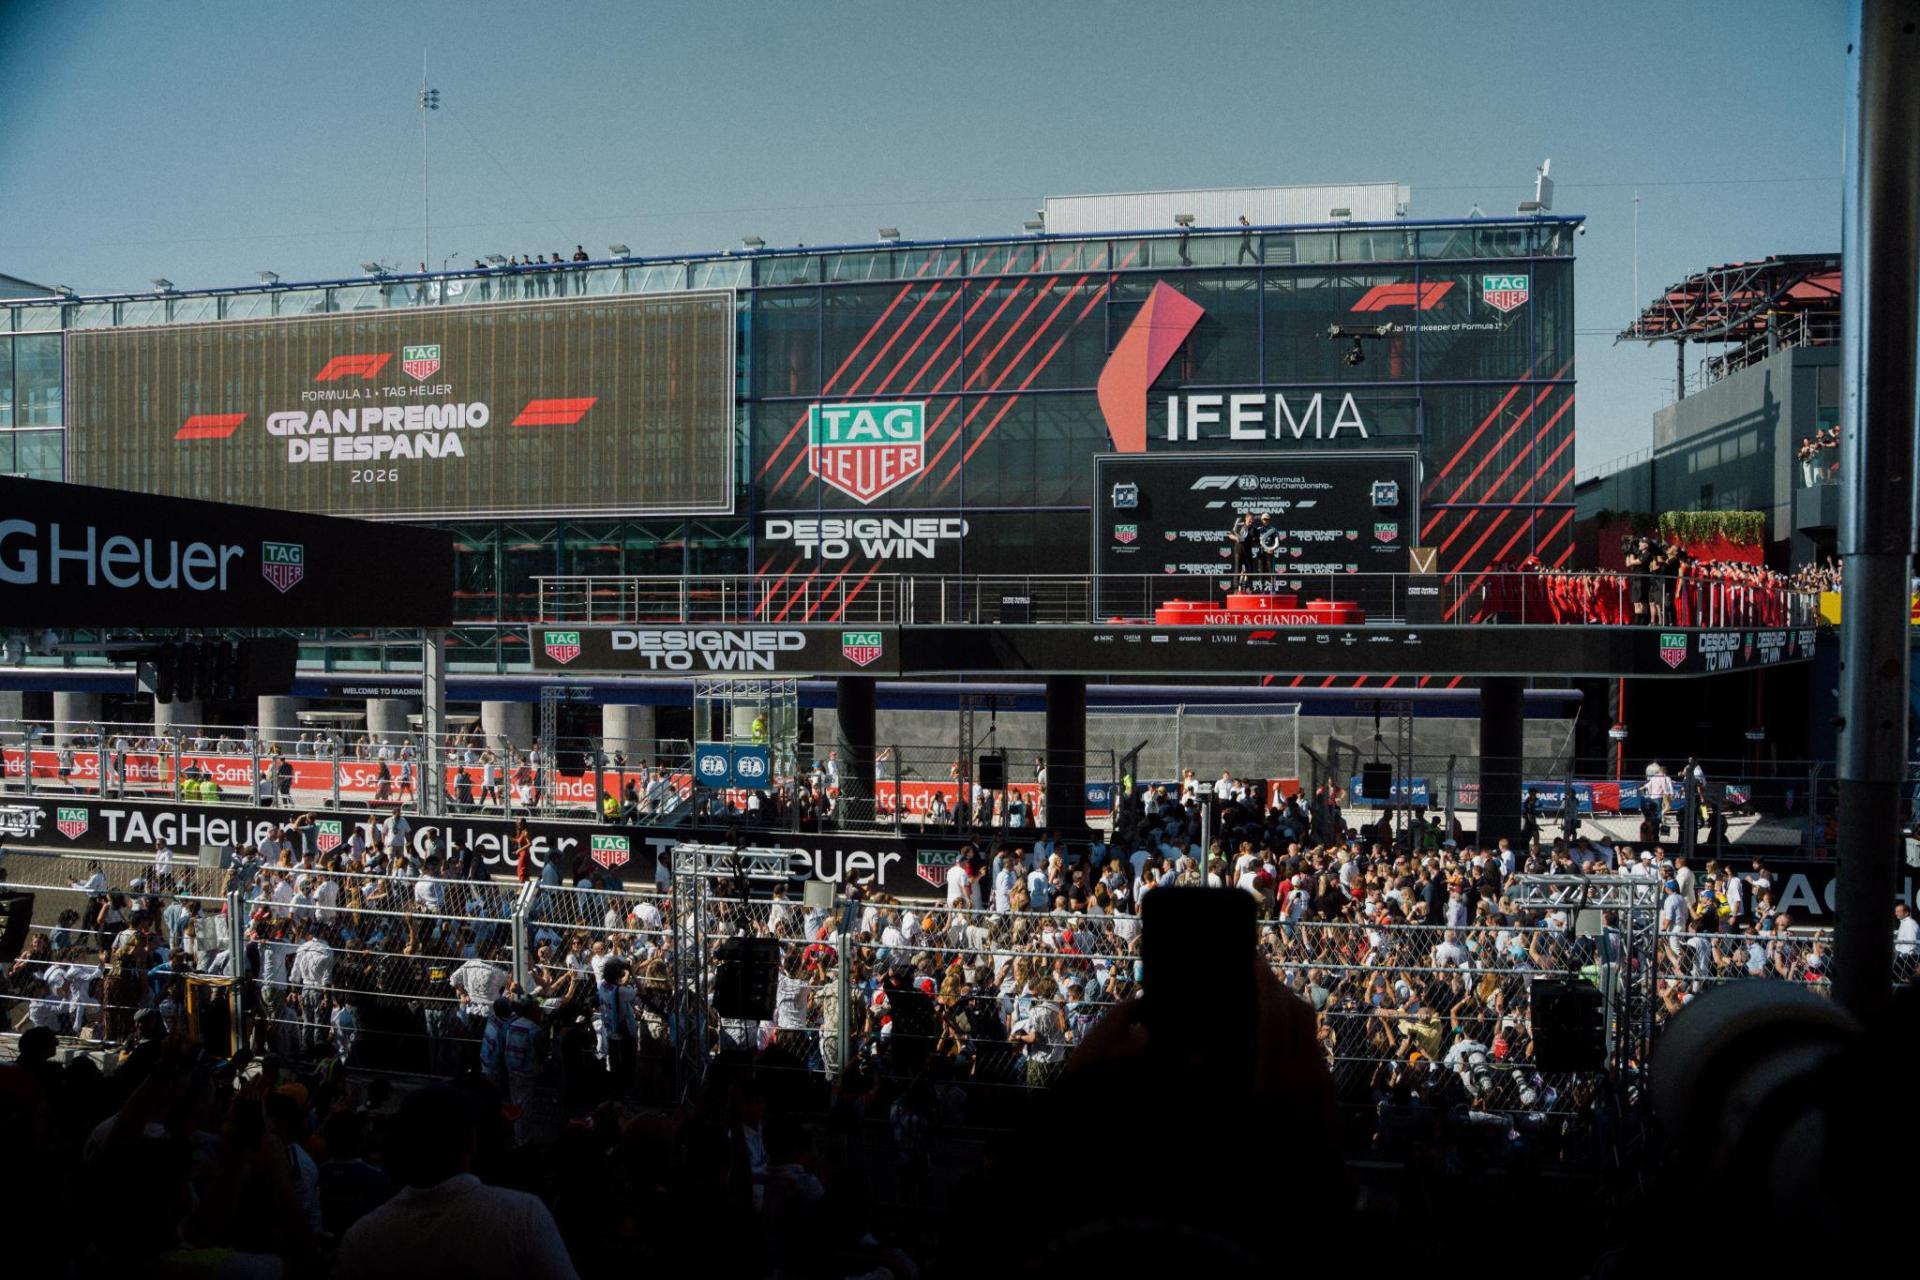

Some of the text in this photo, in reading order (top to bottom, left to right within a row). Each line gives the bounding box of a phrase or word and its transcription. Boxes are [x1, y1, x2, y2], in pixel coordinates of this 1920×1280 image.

[1487, 277, 1525, 289] TAG
[1486, 291, 1526, 309] HEUER
[1461, 322, 1493, 330] Formula
[406, 348, 437, 359] TAG
[405, 360, 438, 378] HEUER
[302, 384, 452, 402] FORMULA 1 TAG HEUER
[266, 401, 490, 436] GRAN PREMIO
[821, 408, 914, 440] TAG
[1167, 392, 1369, 442] IFEMA
[288, 431, 465, 463] DE ESPAÑA
[351, 469, 399, 483] 2026
[814, 446, 918, 495] HEUER
[1257, 500, 1291, 508] PREMIO
[765, 517, 968, 540] DESIGNED
[265, 544, 300, 563] TAG
[795, 538, 935, 560] TO WIN
[264, 564, 302, 589] HEUER
[1260, 598, 1267, 608] 1
[1243, 615, 1253, 625] &
[1254, 614, 1319, 625] CHANDON
[547, 634, 577, 645] TAG
[611, 630, 806, 651] DESIGNED
[846, 635, 878, 645] TAG
[1212, 635, 1237, 643] LVMH
[1663, 635, 1685, 646] TAG
[1698, 633, 1741, 653] DESIGNED
[545, 645, 580, 661] HEUER
[641, 650, 775, 671] TO WIN
[843, 646, 882, 663] HEUER
[1705, 651, 1734, 671] TO WIN
[342, 687, 378, 695] WELCOME
[391, 688, 423, 696] MADRIN
[216, 763, 302, 785] Santr
[701, 760, 726, 772] FIA
[738, 761, 763, 773] FIA
[1087, 790, 1105, 800] FIA
[61, 810, 85, 820] TAG
[59, 821, 87, 839] HEUER
[317, 835, 341, 851] EUER
[594, 837, 626, 849] TAG
[593, 850, 627, 868] HEUER
[920, 852, 957, 865] TAG
[919, 866, 948, 884] HEU
